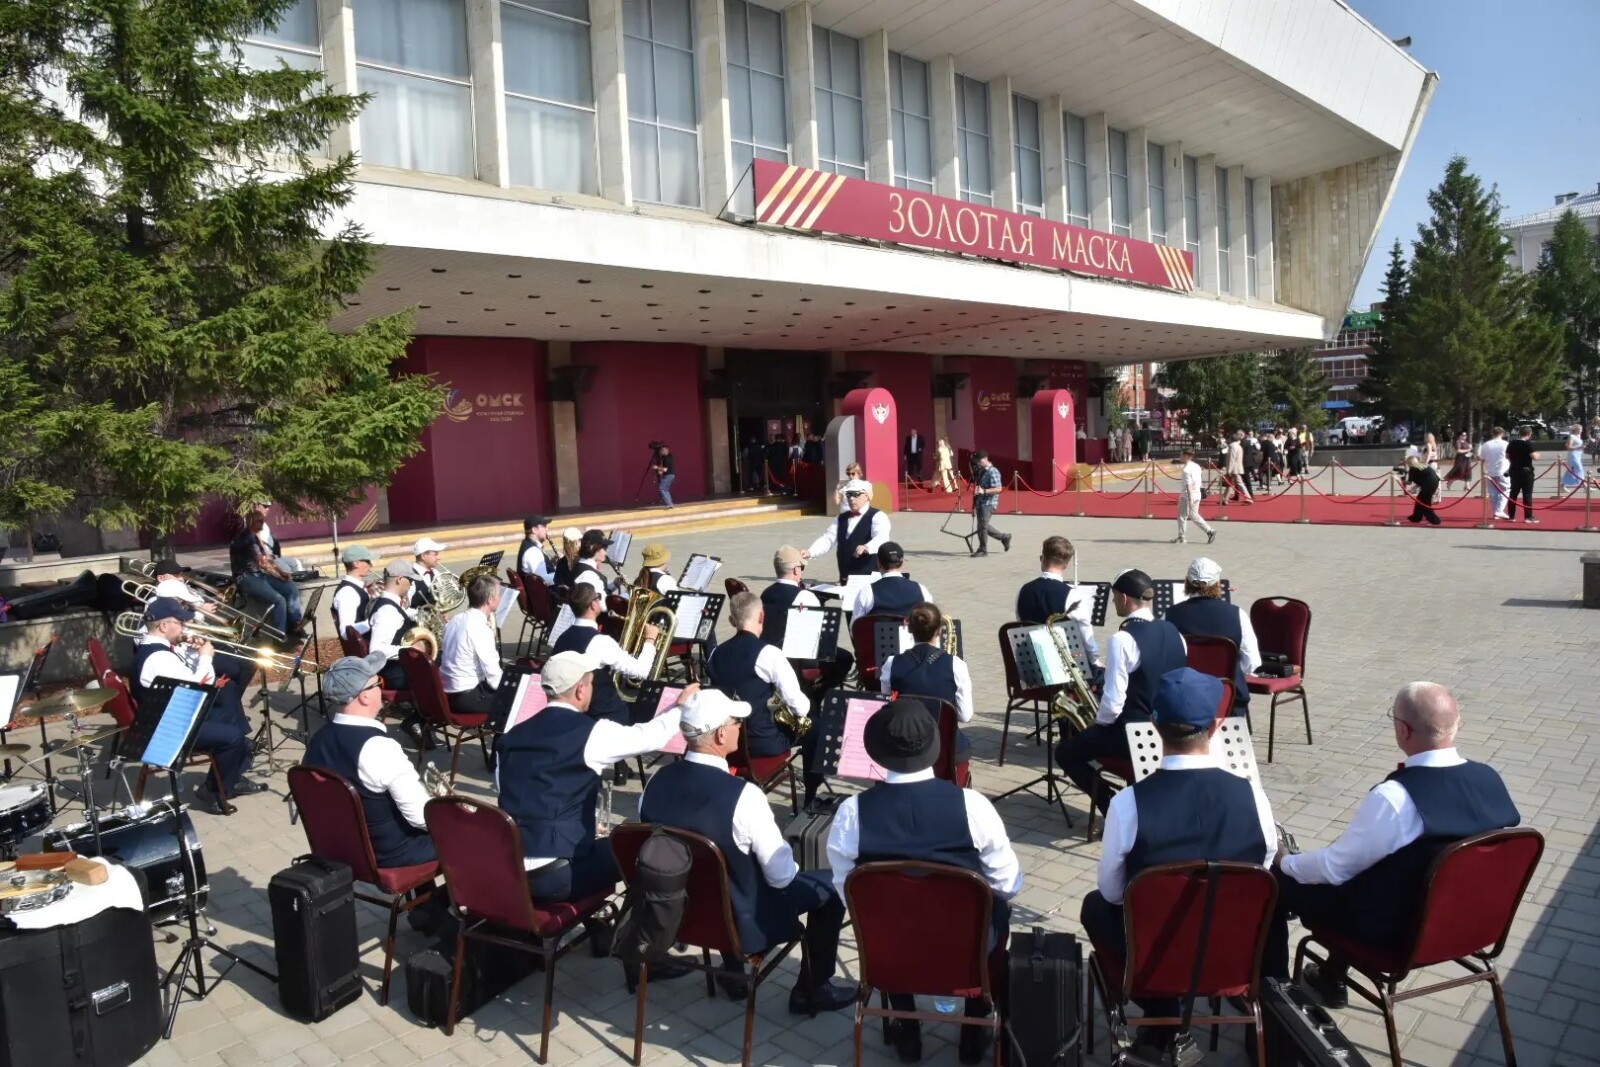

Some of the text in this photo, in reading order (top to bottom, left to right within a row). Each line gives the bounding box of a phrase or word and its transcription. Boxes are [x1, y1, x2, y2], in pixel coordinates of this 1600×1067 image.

[888, 192, 1134, 274] ЗОЛОТАЯ МАСКА
[476, 393, 524, 407] ОМСК
